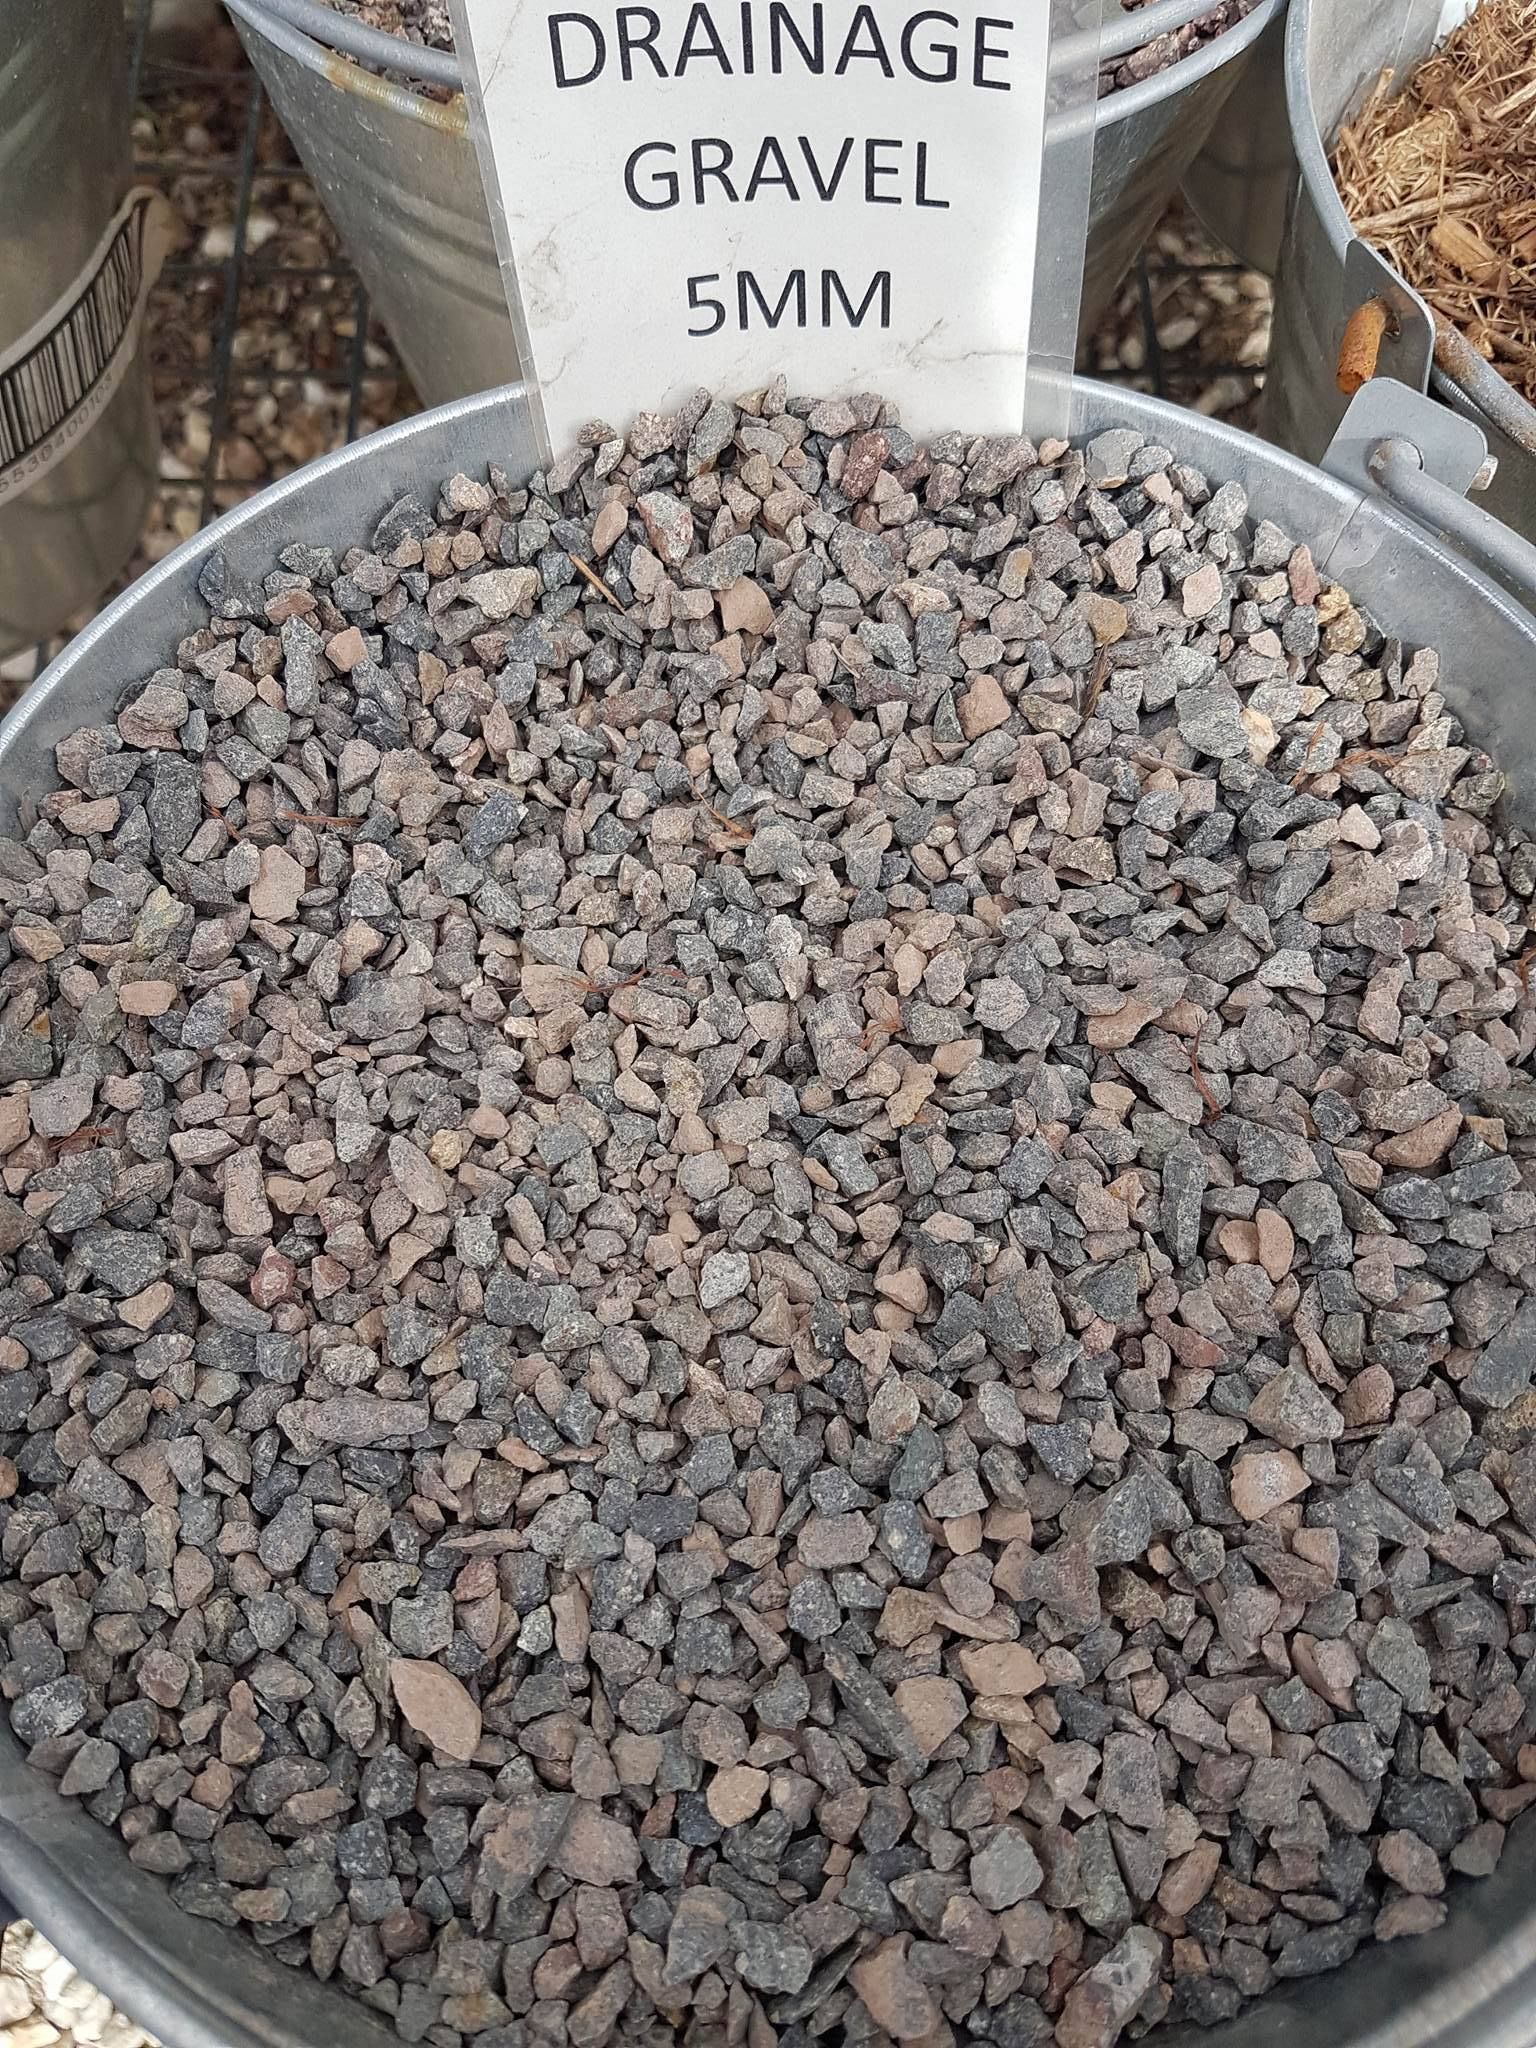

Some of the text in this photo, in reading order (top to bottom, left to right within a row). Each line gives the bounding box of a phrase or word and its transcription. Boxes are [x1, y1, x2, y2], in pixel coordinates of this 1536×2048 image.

[547, 2, 1015, 91] DRAINAGE
[624, 136, 950, 210] GRAVEL
[687, 269, 891, 337] 5MM
